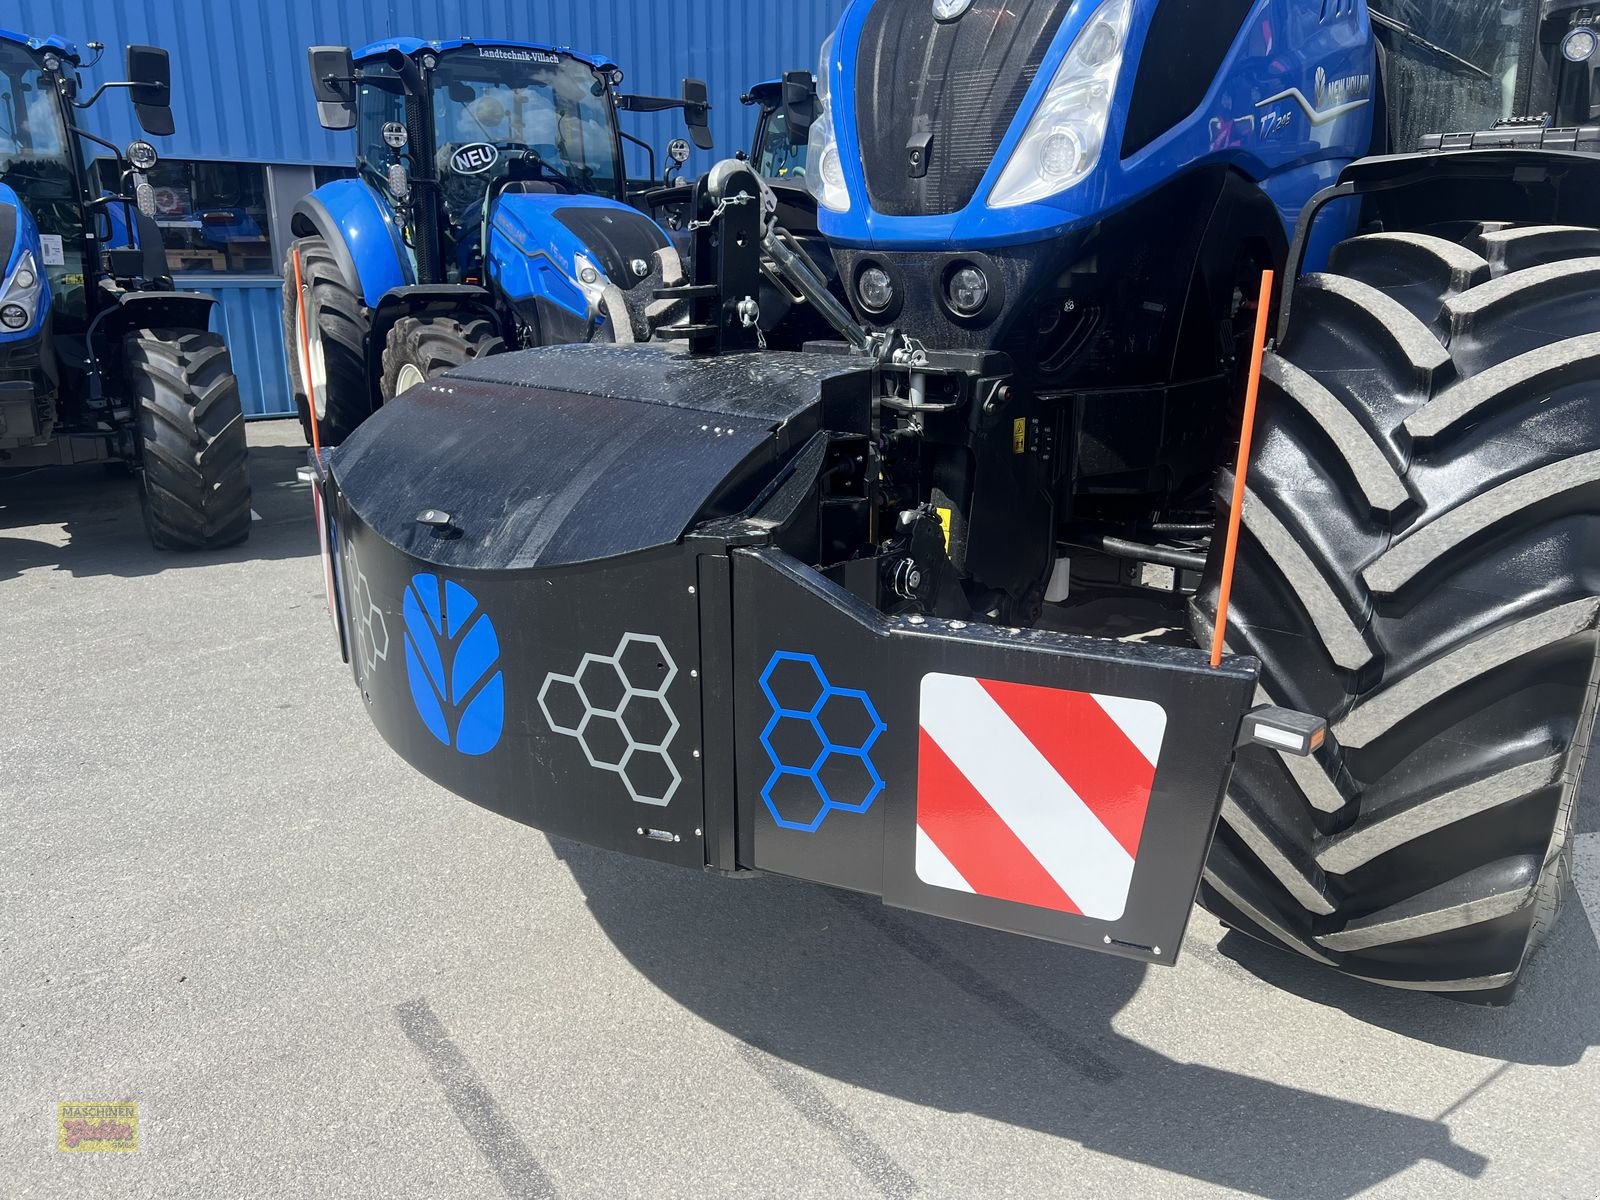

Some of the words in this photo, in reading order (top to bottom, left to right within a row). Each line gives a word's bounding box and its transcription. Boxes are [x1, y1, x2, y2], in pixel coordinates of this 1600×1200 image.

[478, 48, 560, 63] Landtechnik-Villach
[1328, 78, 1346, 98] NEW
[455, 146, 492, 170] NEU
